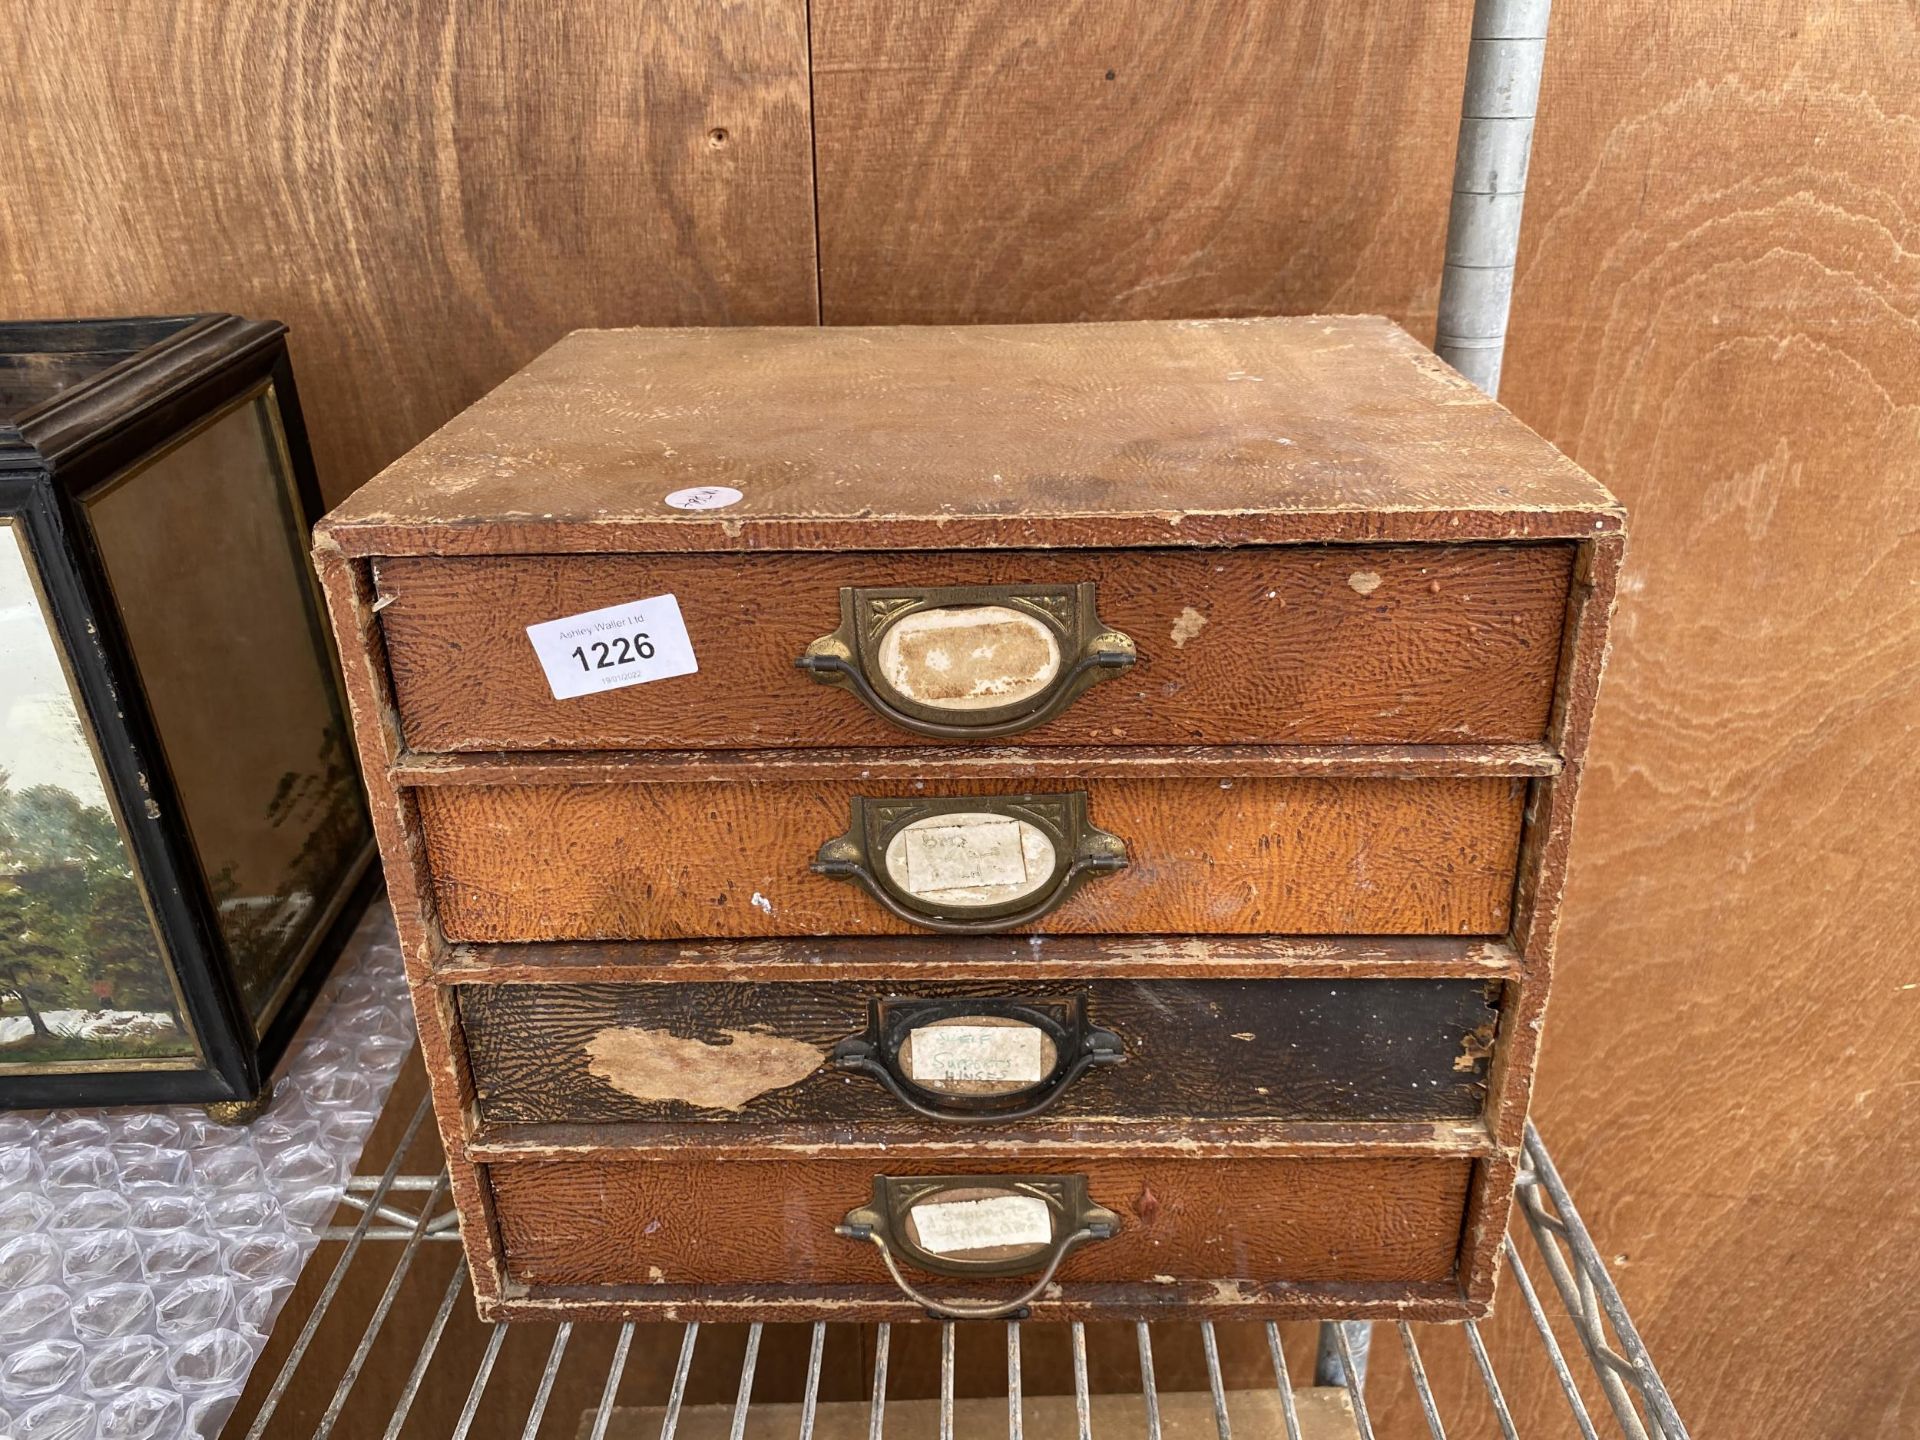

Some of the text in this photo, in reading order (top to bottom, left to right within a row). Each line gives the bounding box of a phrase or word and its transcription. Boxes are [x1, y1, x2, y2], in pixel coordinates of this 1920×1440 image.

[559, 614, 645, 640] Ashley Waller Ltd
[572, 633, 655, 672] 1226
